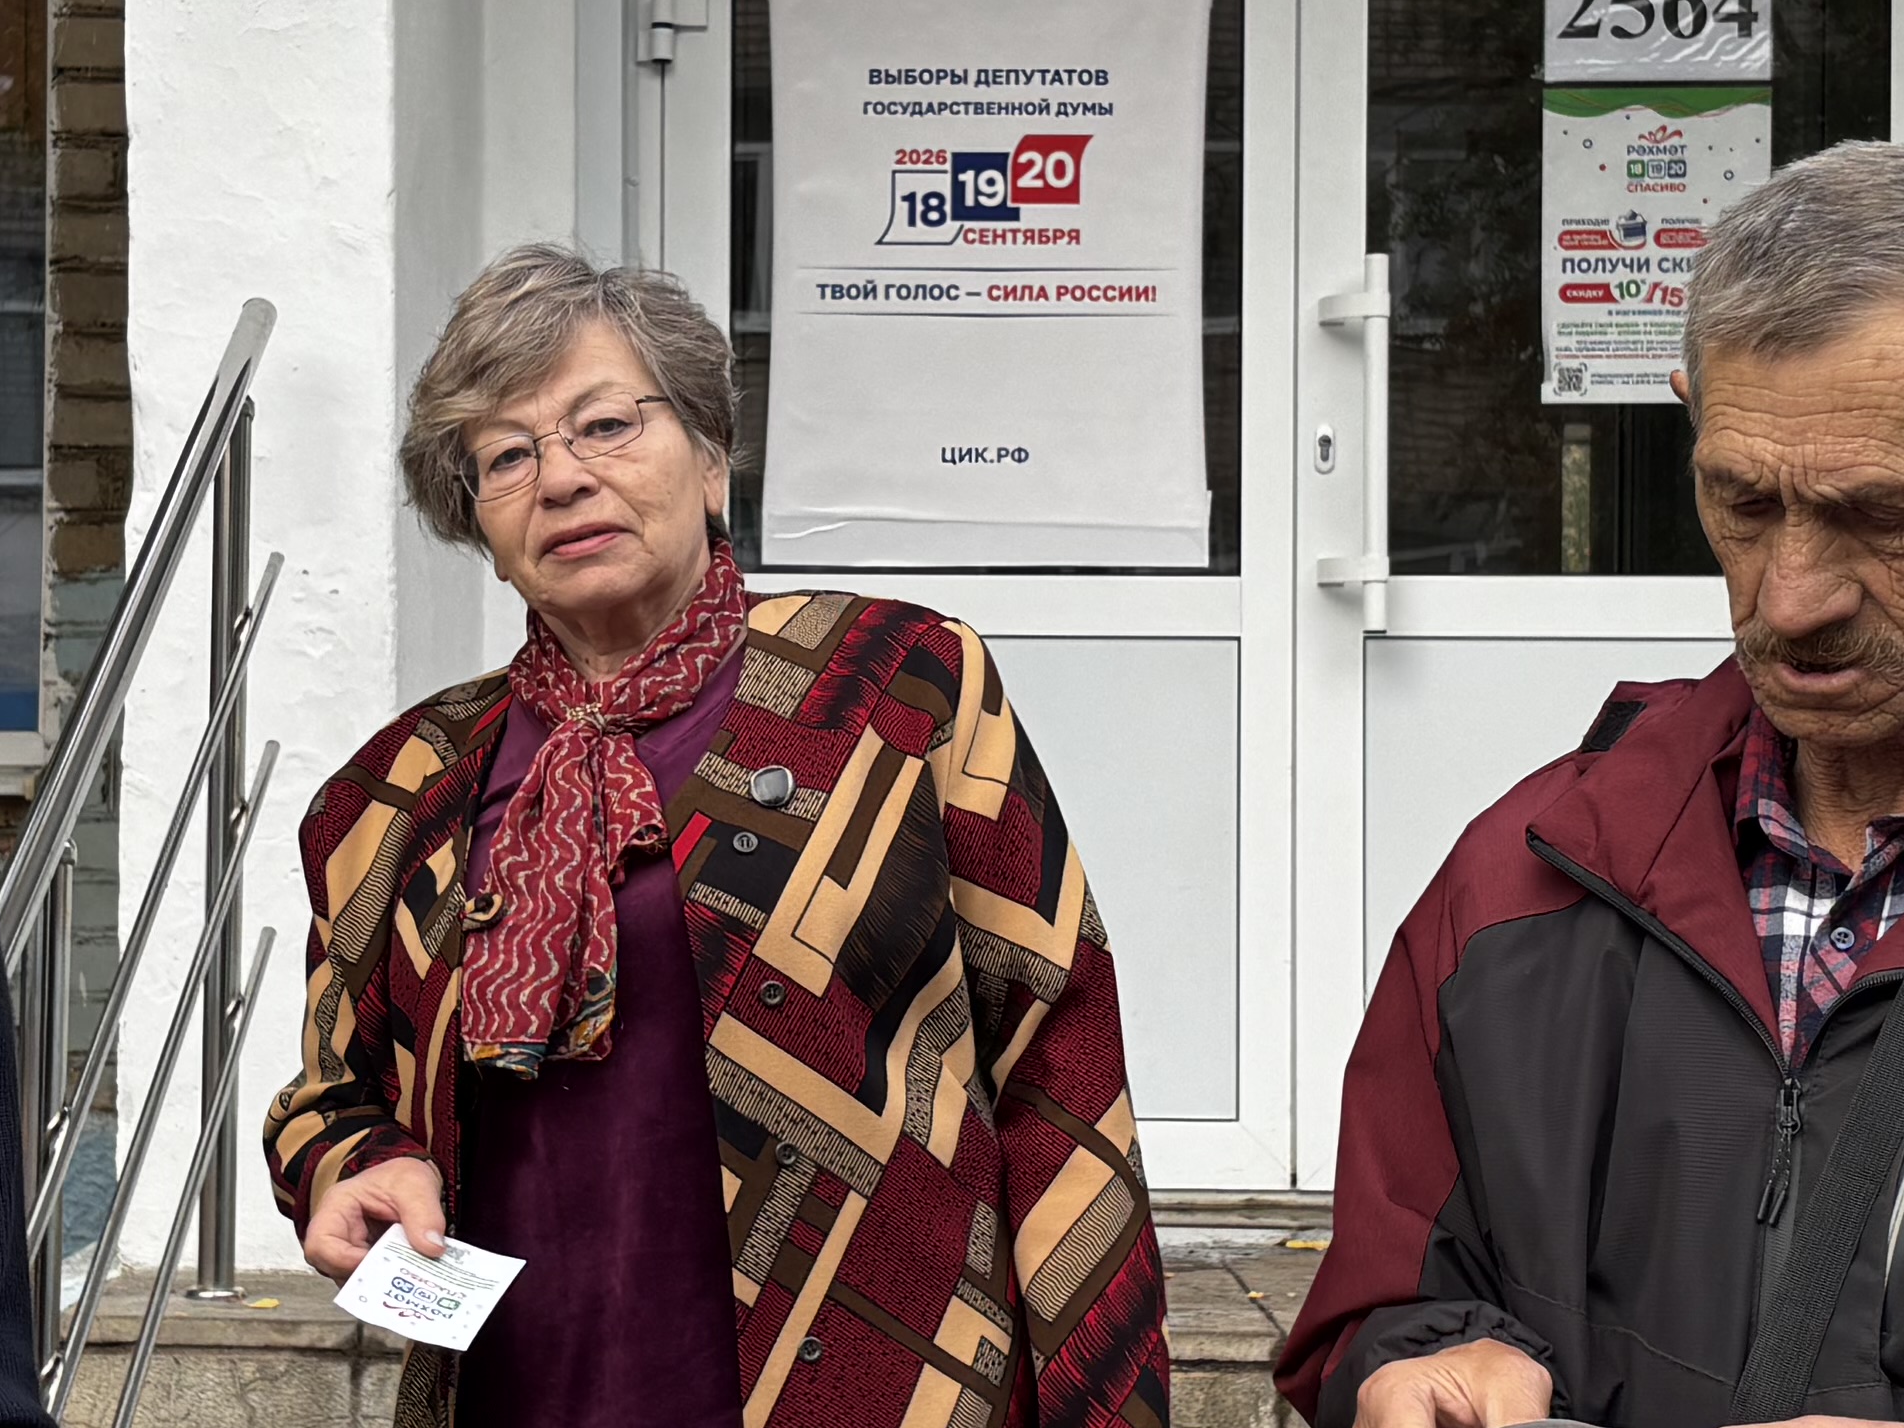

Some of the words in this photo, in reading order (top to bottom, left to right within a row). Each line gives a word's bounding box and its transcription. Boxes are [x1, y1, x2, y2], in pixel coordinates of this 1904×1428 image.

[868, 68, 968, 86] ВЫБОРЫ
[974, 68, 1110, 88] ДЕПУТАТОВ
[862, 98, 1051, 117] ГОСУДАРСТВЕННОЙ
[1055, 102, 1114, 118] ДУМЫ
[893, 148, 948, 166] 2026
[1668, 162, 1685, 175] 20
[900, 190, 948, 228] 18
[957, 169, 1006, 207] 19
[1016, 150, 1076, 189] 20
[1626, 182, 1687, 193] СПАСИБО
[962, 228, 1081, 245] СЕНТЯБРЯ
[1561, 257, 1651, 275] ПОЛУЧИ
[816, 279, 878, 301] ТВОЙ
[884, 283, 961, 302] ГОЛОС
[987, 284, 1050, 302] СИЛА
[1055, 284, 1158, 303] РОССИИ!
[940, 446, 1030, 466] ЦИК.РФ
